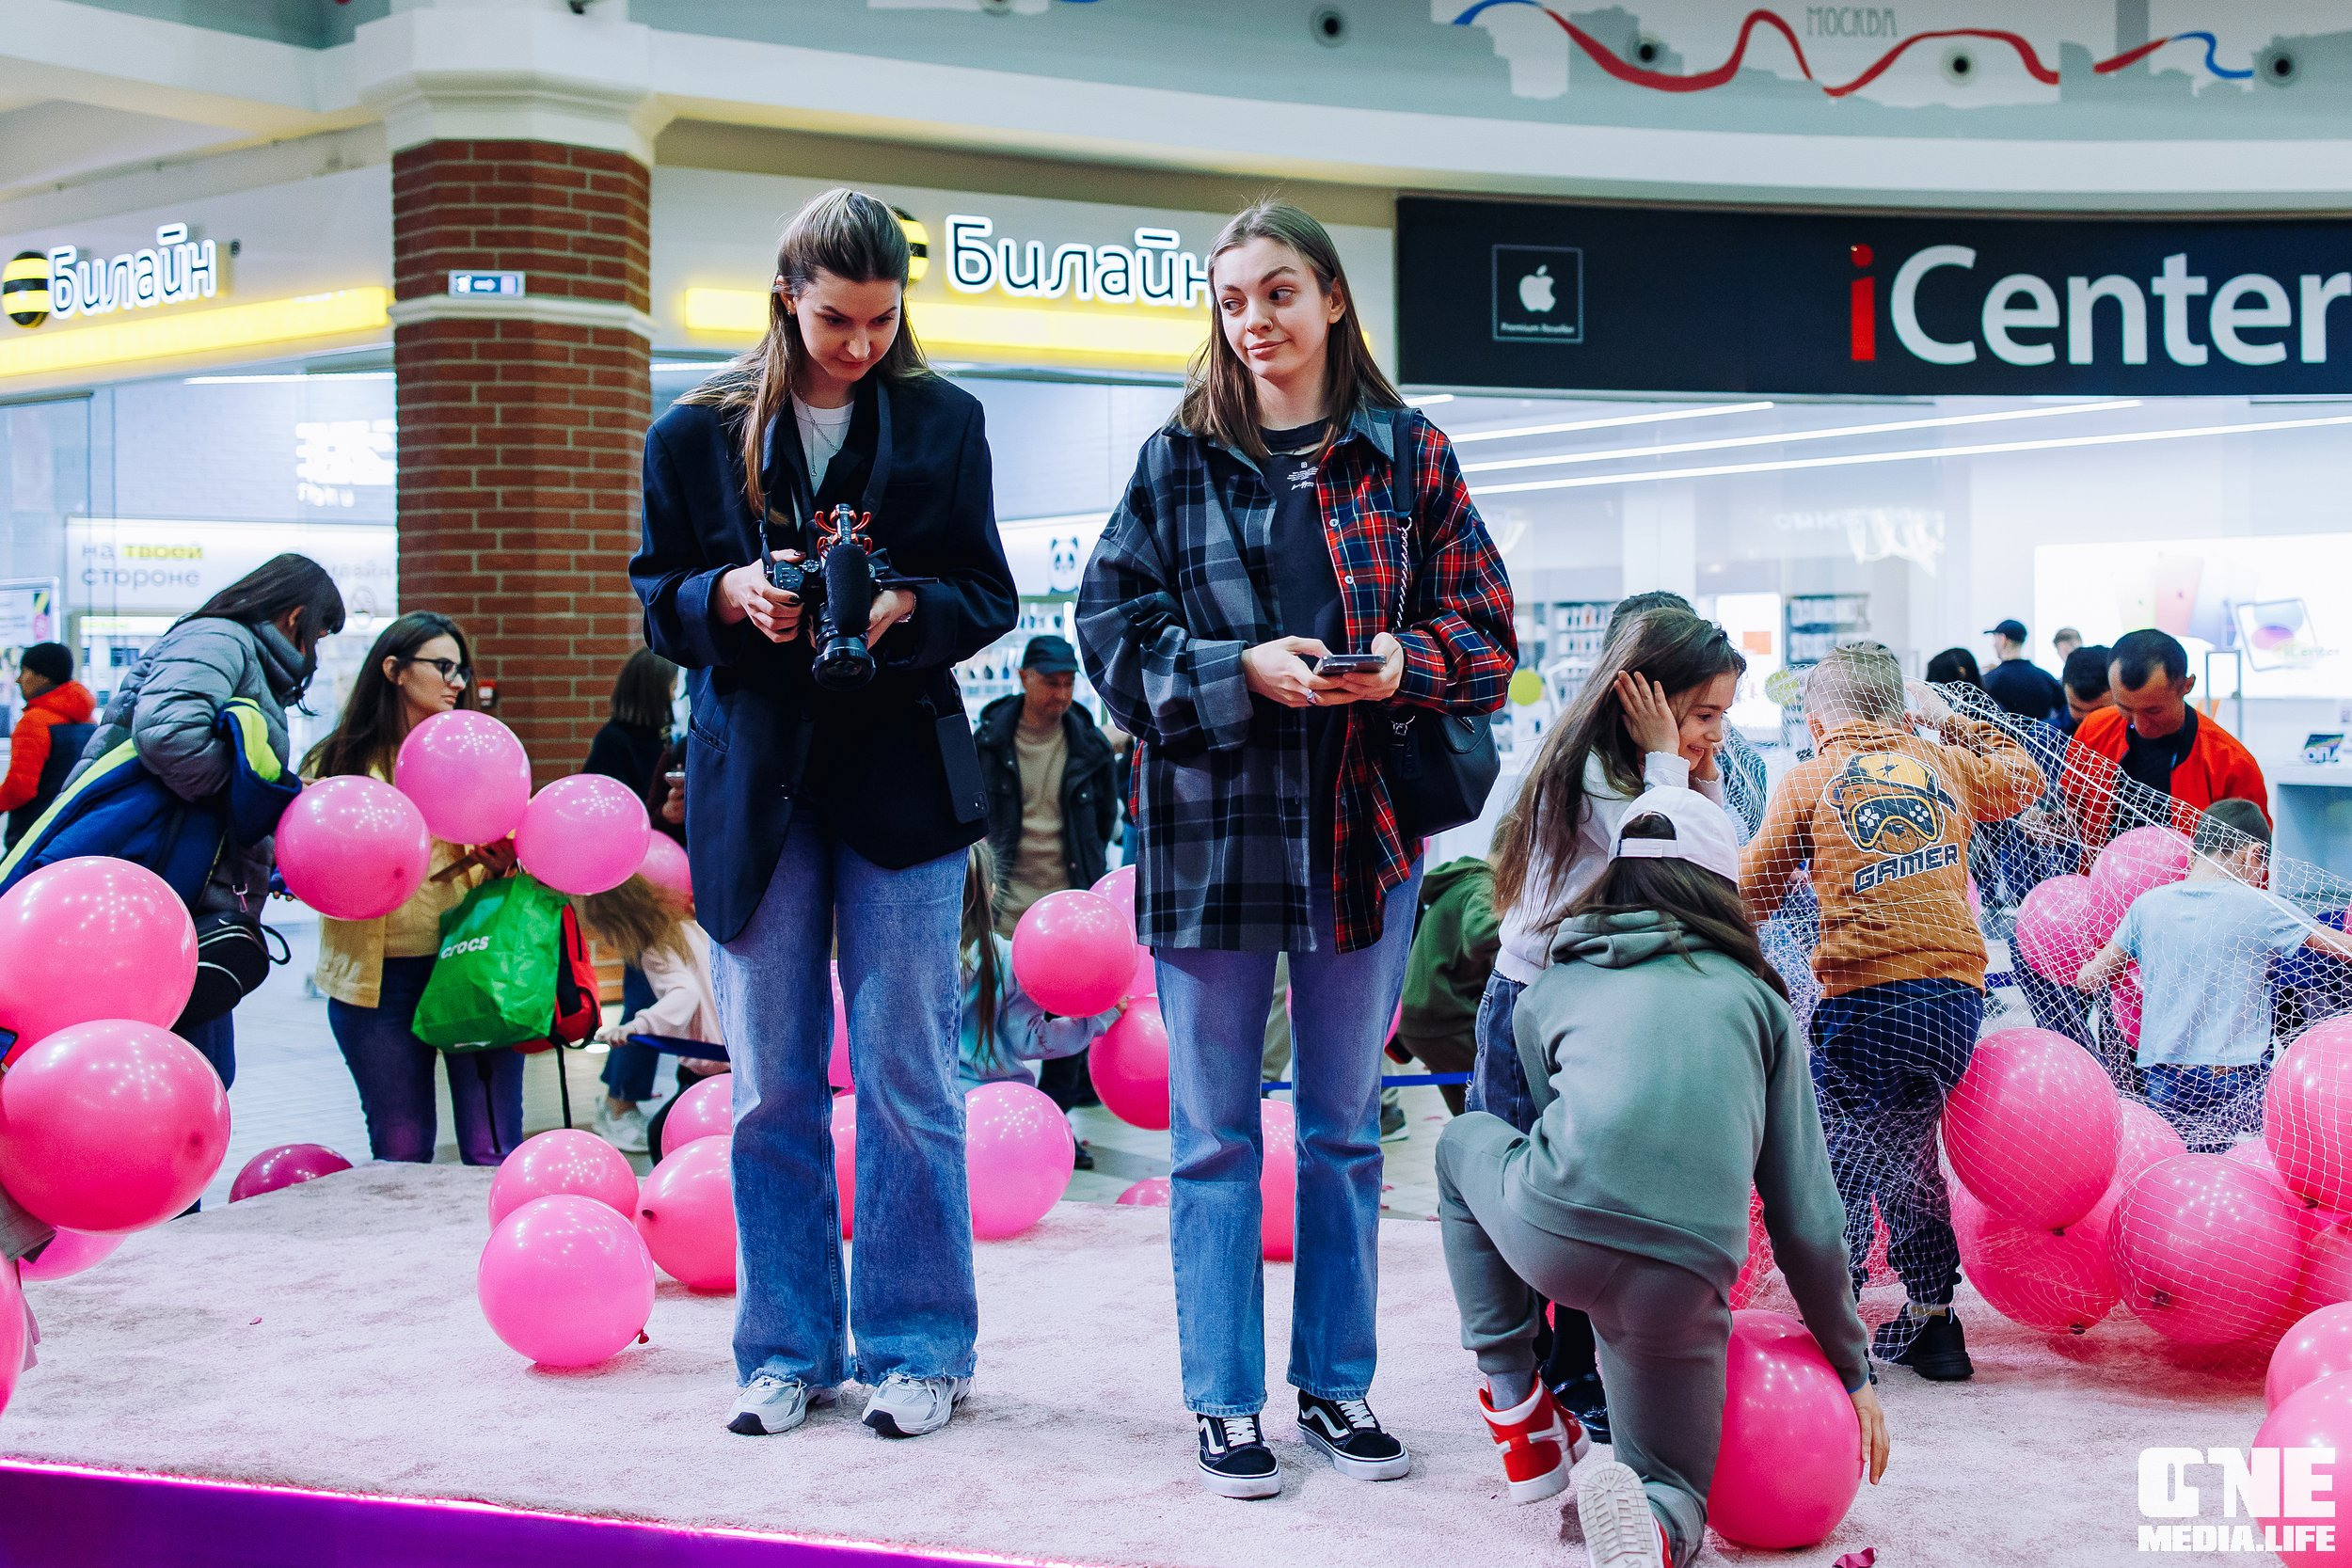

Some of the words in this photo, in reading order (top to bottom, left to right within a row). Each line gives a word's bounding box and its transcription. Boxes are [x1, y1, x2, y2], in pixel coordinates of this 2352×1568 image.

[1806, 7, 1898, 38] МОСКВА
[48, 222, 217, 320] Билайн
[1851, 243, 2352, 367] iCenter
[81, 567, 201, 591] стороне
[1853, 843, 1959, 895] GAMER
[440, 936, 490, 959] crocs
